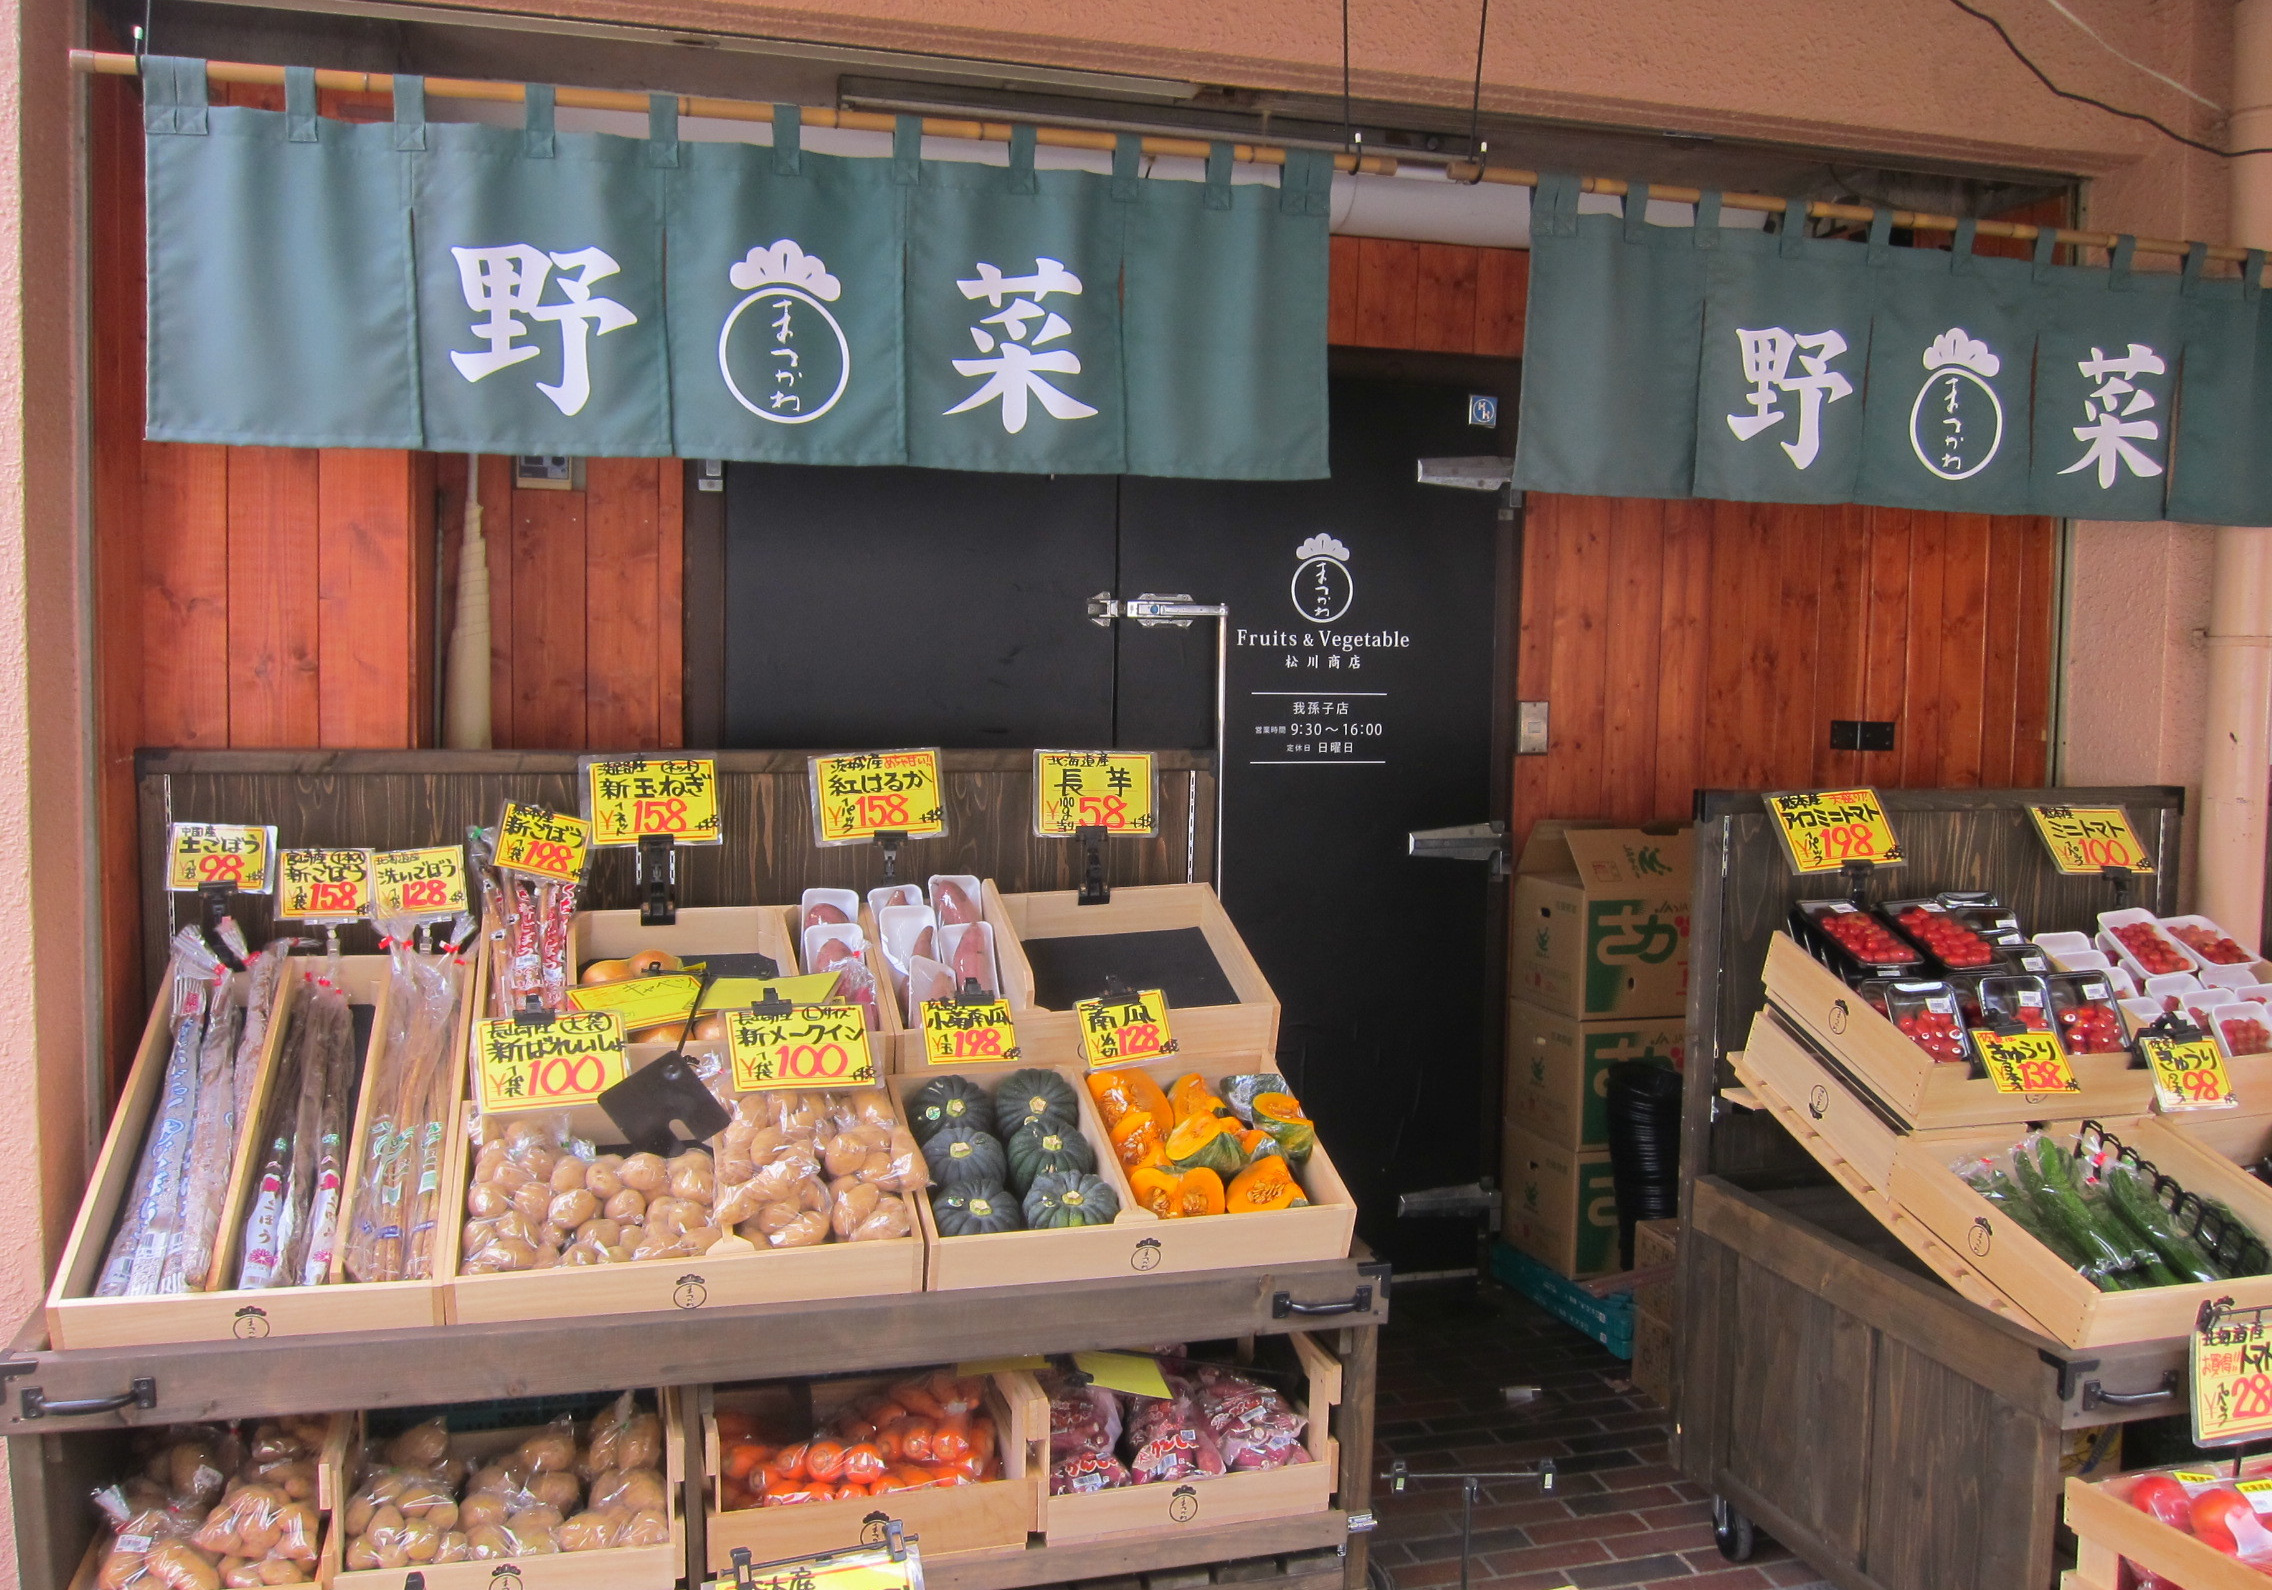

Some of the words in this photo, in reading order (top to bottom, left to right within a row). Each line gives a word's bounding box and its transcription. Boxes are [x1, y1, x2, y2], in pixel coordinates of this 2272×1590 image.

[450, 243, 638, 416] 野
[942, 257, 1099, 434] 菜
[770, 300, 802, 412] まつかわ
[1726, 327, 1853, 470] 野
[2056, 343, 2167, 489] 菜
[1942, 377, 1964, 470] まつかわ
[1314, 562, 1331, 617] まつかわ
[1237, 629, 1298, 647] Fruits
[1303, 633, 1314, 647] &
[1318, 630, 1410, 652] Vegetable
[1285, 654, 1361, 669] 松川商店
[1293, 701, 1349, 715] 我孫子店
[1255, 726, 1287, 735] 営業時間
[1047, 751, 1109, 767] 北海道産
[1286, 743, 1311, 752] 定休日
[1318, 742, 1354, 754] 日曜日
[599, 773, 711, 799] 新玉ねぎ
[828, 770, 932, 796] 紅はるか
[633, 798, 687, 833] 158
[855, 794, 910, 827] 158
[182, 824, 216, 837] 中国産
[504, 815, 583, 848] 新ごぼう
[1820, 824, 1875, 858] 198
[2048, 820, 2125, 838] ミニトマト
[179, 834, 260, 854] 土ごぼう
[522, 840, 575, 873] 198
[2078, 838, 2130, 866] 100
[199, 854, 245, 882] 98
[285, 864, 368, 884] 新ごぼう
[378, 859, 456, 885] 洗いごぼう
[310, 881, 358, 910] 158
[402, 879, 447, 908] 128
[1087, 1004, 1157, 1033] 南瓜
[486, 1034, 627, 1063] 新ばれいしょ
[735, 1024, 865, 1047] 新メークイン
[953, 1028, 1001, 1057] 198
[1114, 1024, 1160, 1056] 128
[775, 1044, 848, 1077] 100
[1985, 1040, 2056, 1063] きゅうり
[2155, 1047, 2217, 1071] きゅうり
[528, 1055, 605, 1095] 100
[2182, 1069, 2219, 1101] 98
[2231, 1373, 2272, 1418] 28
